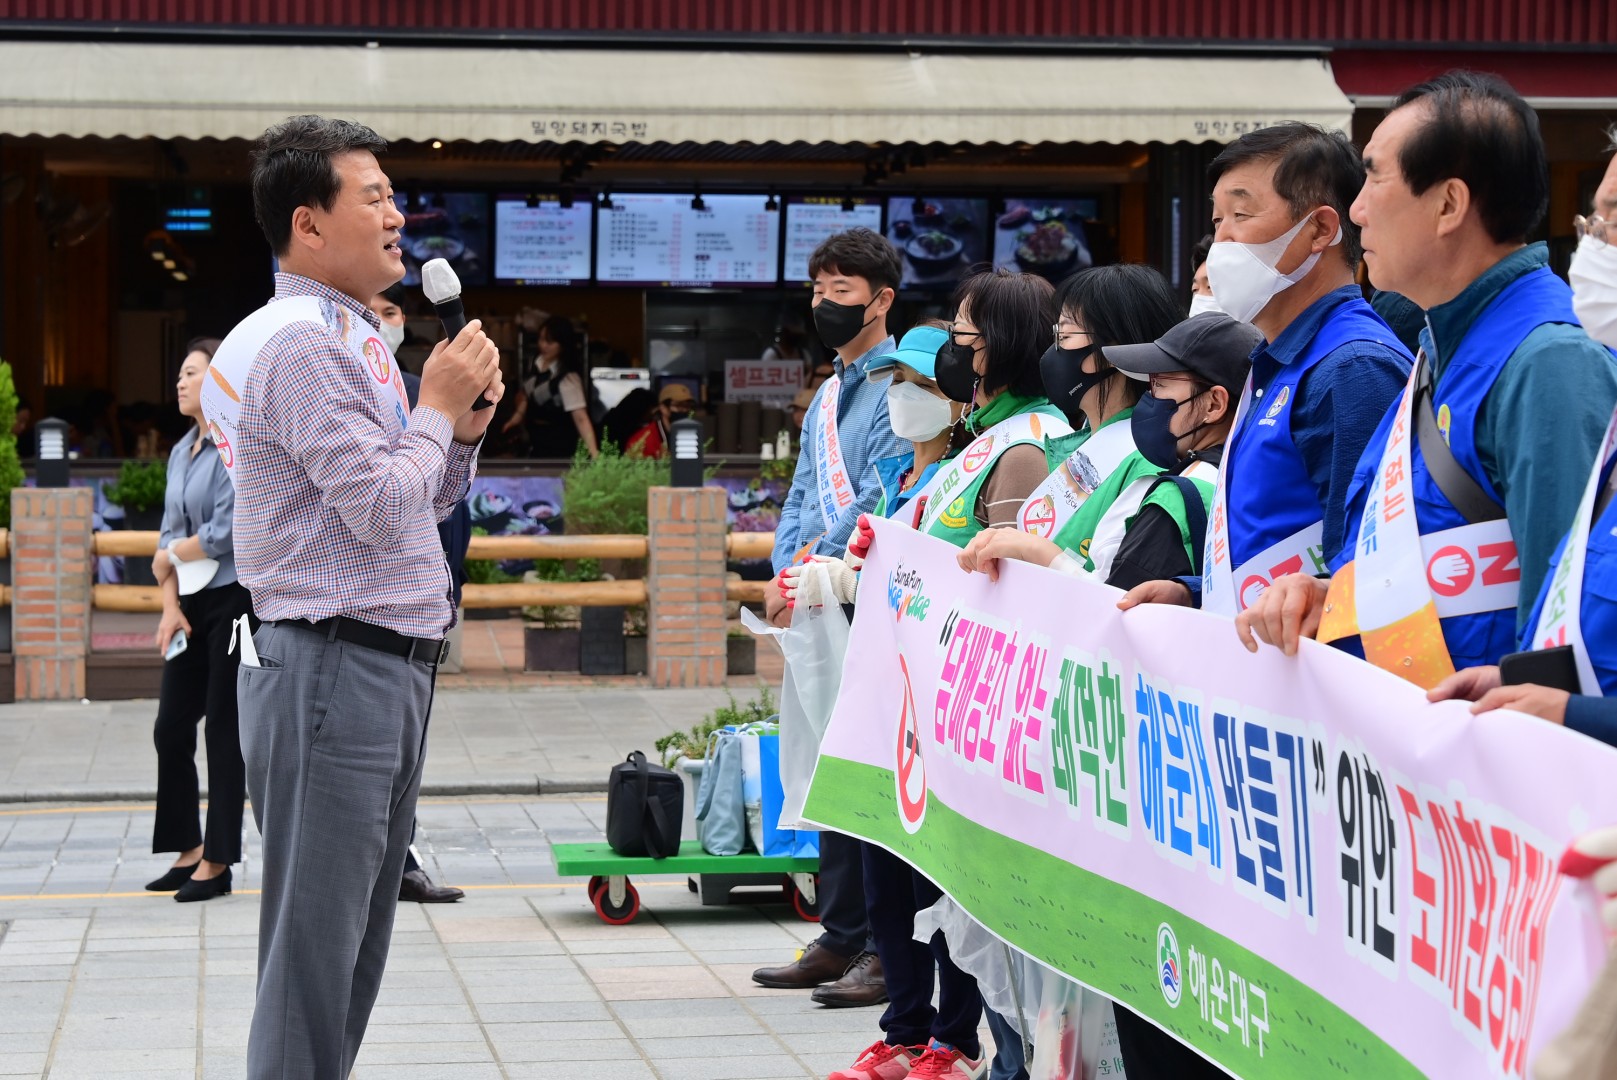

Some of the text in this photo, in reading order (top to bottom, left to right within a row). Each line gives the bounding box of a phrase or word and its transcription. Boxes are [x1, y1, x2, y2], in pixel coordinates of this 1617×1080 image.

[531, 121, 648, 138] 밀양돼지국밥
[729, 366, 802, 389] 셀프코너
[822, 493, 839, 524] 만들기
[1002, 642, 1048, 795] 없는
[1050, 657, 1128, 828] 쾌적한
[1135, 672, 1222, 870] 해운대
[1337, 750, 1396, 963] 위한
[1188, 944, 1270, 1058] 해운대구
